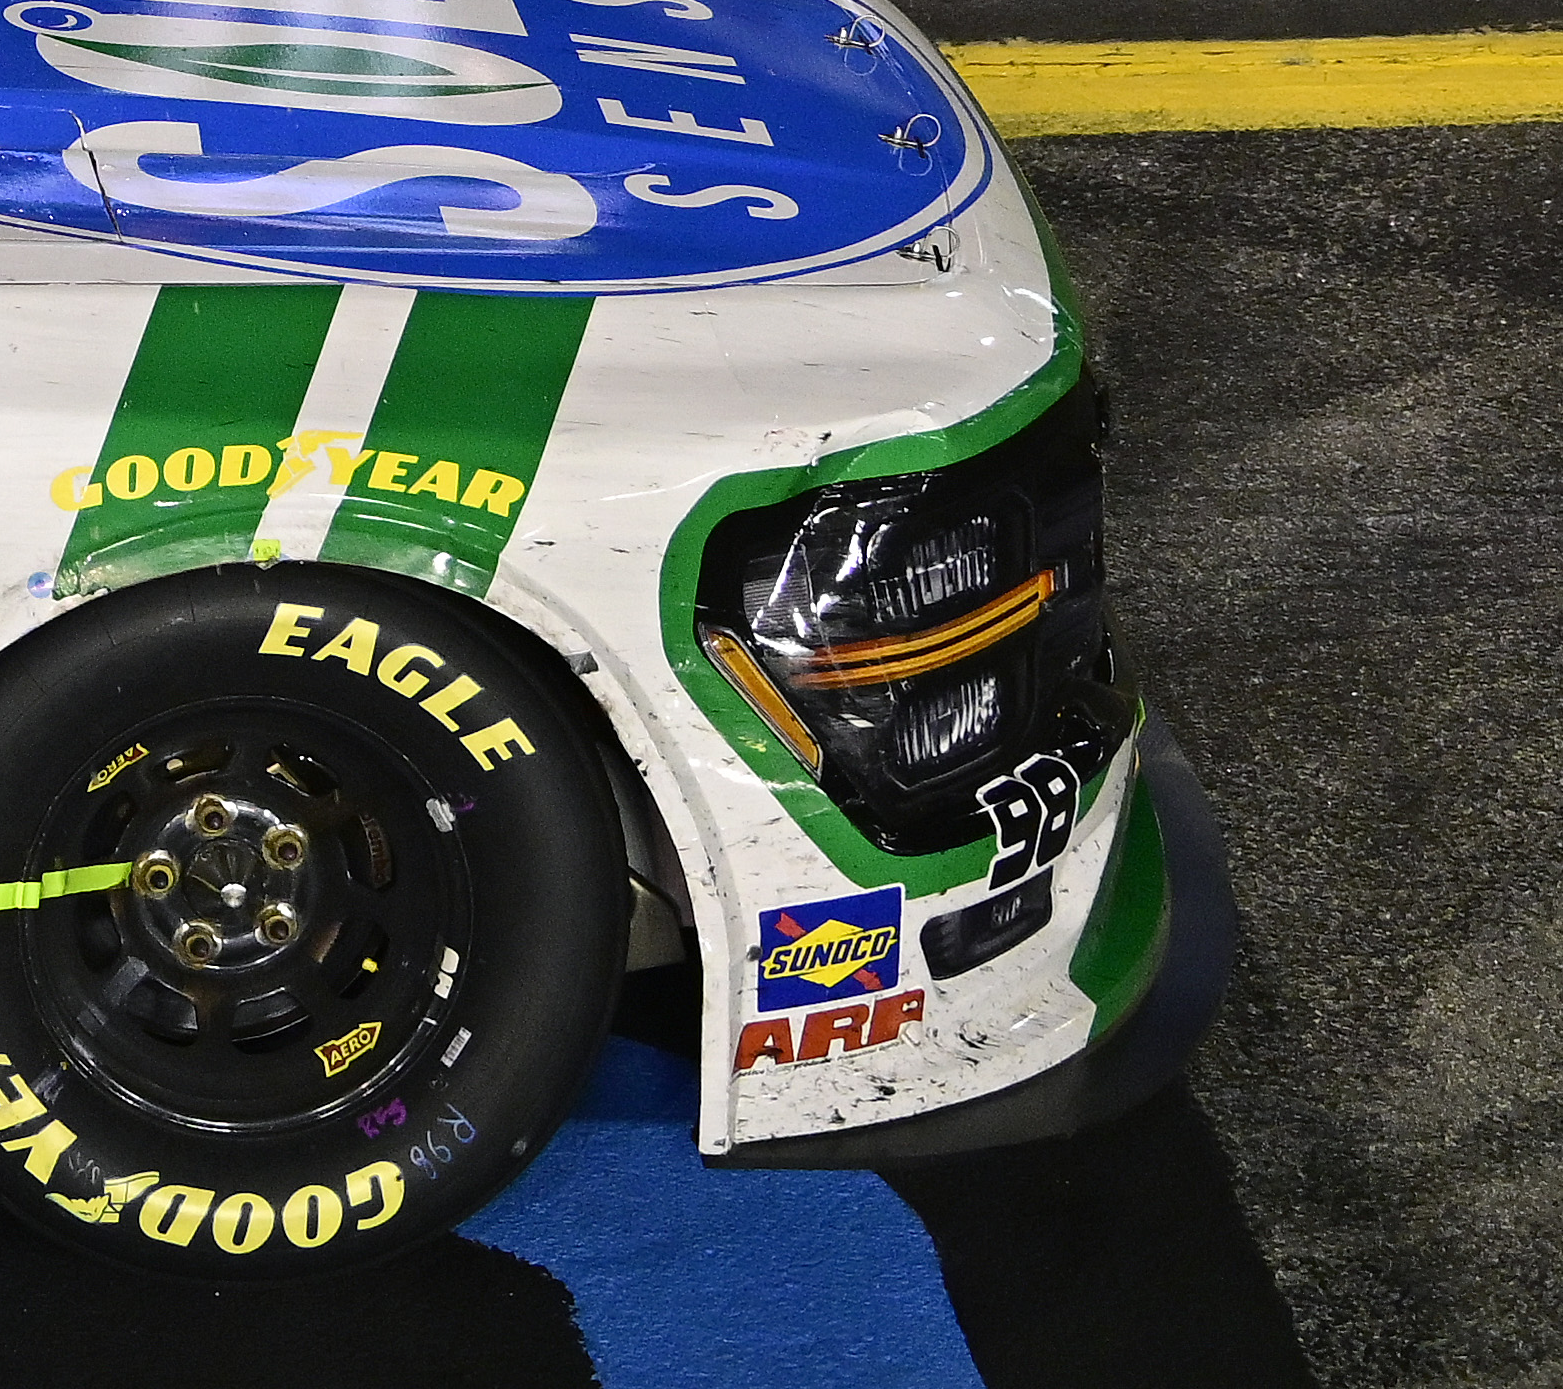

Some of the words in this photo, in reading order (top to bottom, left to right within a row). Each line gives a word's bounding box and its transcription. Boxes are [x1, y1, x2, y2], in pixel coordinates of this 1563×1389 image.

[50, 430, 527, 518] GOODYEAR
[258, 603, 537, 773] EAGLE
[977, 754, 1081, 891] 98
[768, 932, 895, 976] SUNOCO
[329, 1028, 371, 1067] AERO
[734, 989, 926, 1072] ARP
[410, 1102, 477, 1180] R98
